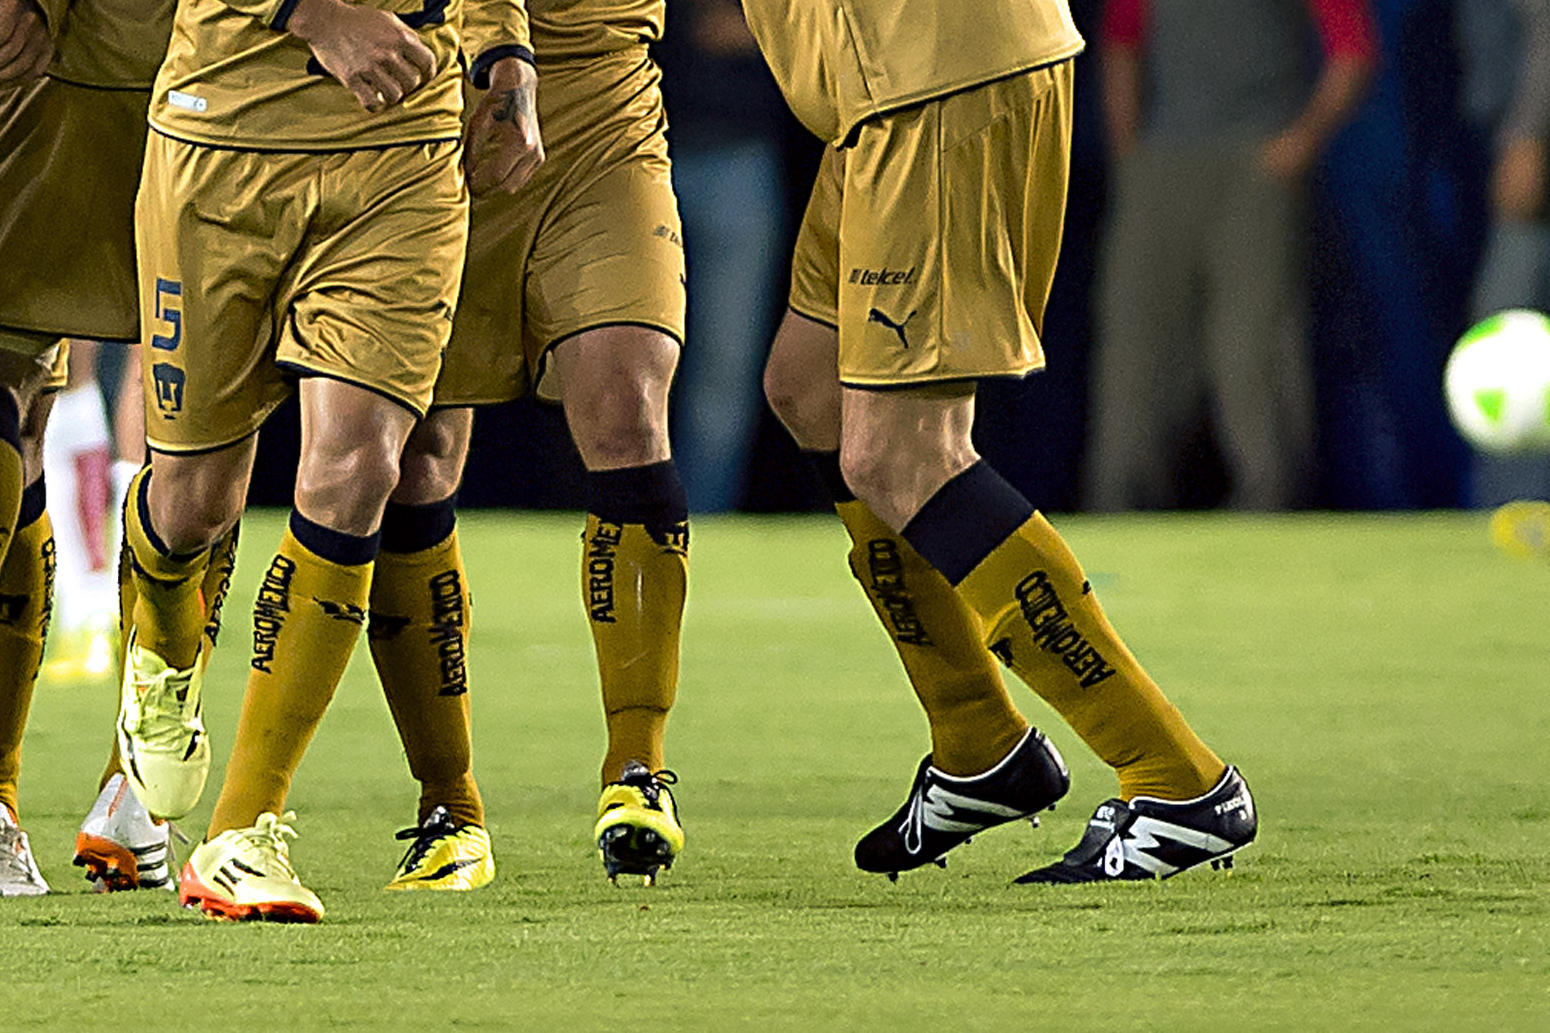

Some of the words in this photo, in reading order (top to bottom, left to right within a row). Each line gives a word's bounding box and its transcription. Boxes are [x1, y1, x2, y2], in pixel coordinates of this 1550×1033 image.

[152, 278, 181, 351] 5
[860, 266, 916, 286] telcel
[251, 554, 297, 674] AEROMEXICO
[589, 523, 623, 623] AEROME
[1014, 570, 1116, 690] AEROMEXICO
